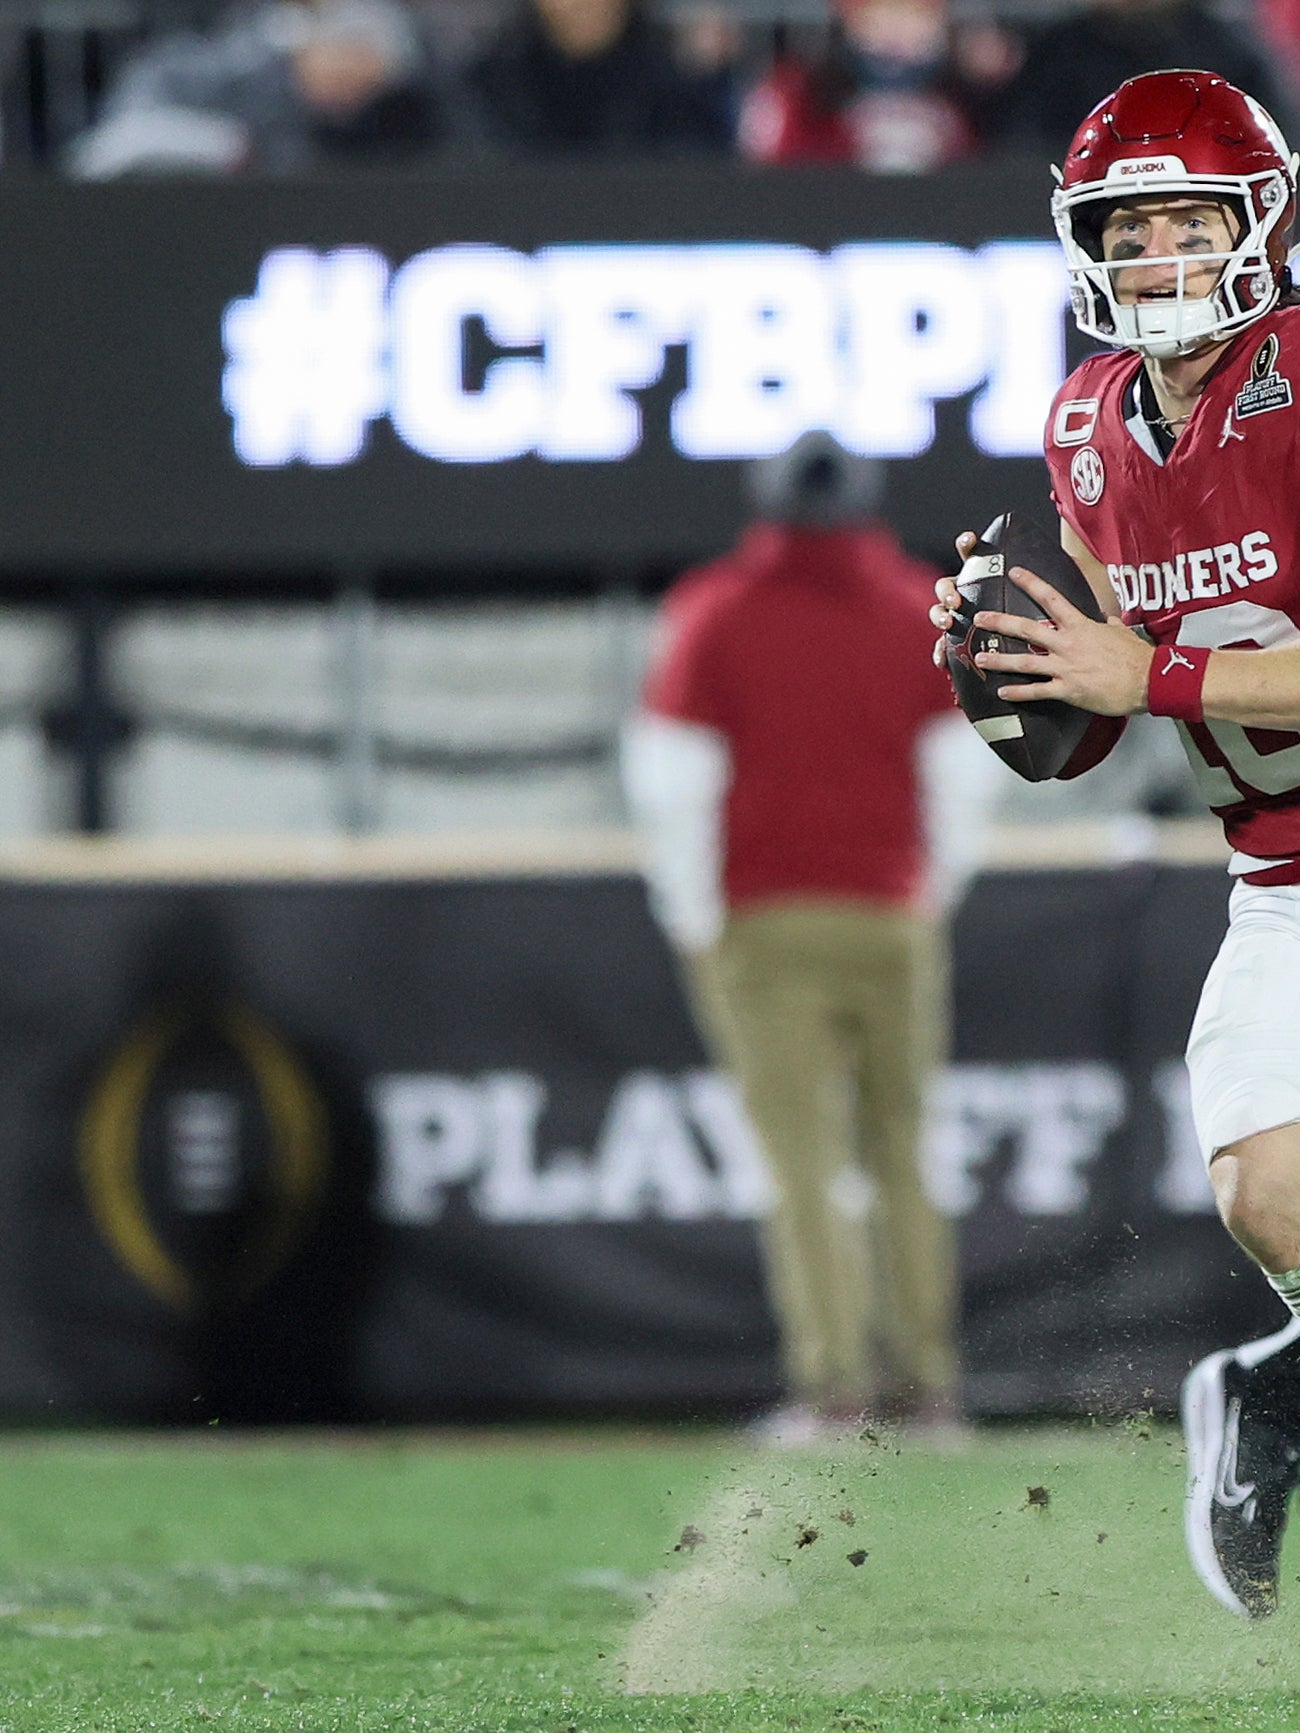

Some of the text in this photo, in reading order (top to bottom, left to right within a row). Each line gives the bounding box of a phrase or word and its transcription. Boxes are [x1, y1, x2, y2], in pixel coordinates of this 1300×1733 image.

[1120, 163, 1167, 175] OKLAHOMA
[1259, 384, 1286, 400] ROUND
[1055, 401, 1097, 443] C
[1073, 449, 1102, 501] SEC
[1106, 530, 1279, 612] SOONERS
[363, 1061, 1128, 1226] PLAYFF
